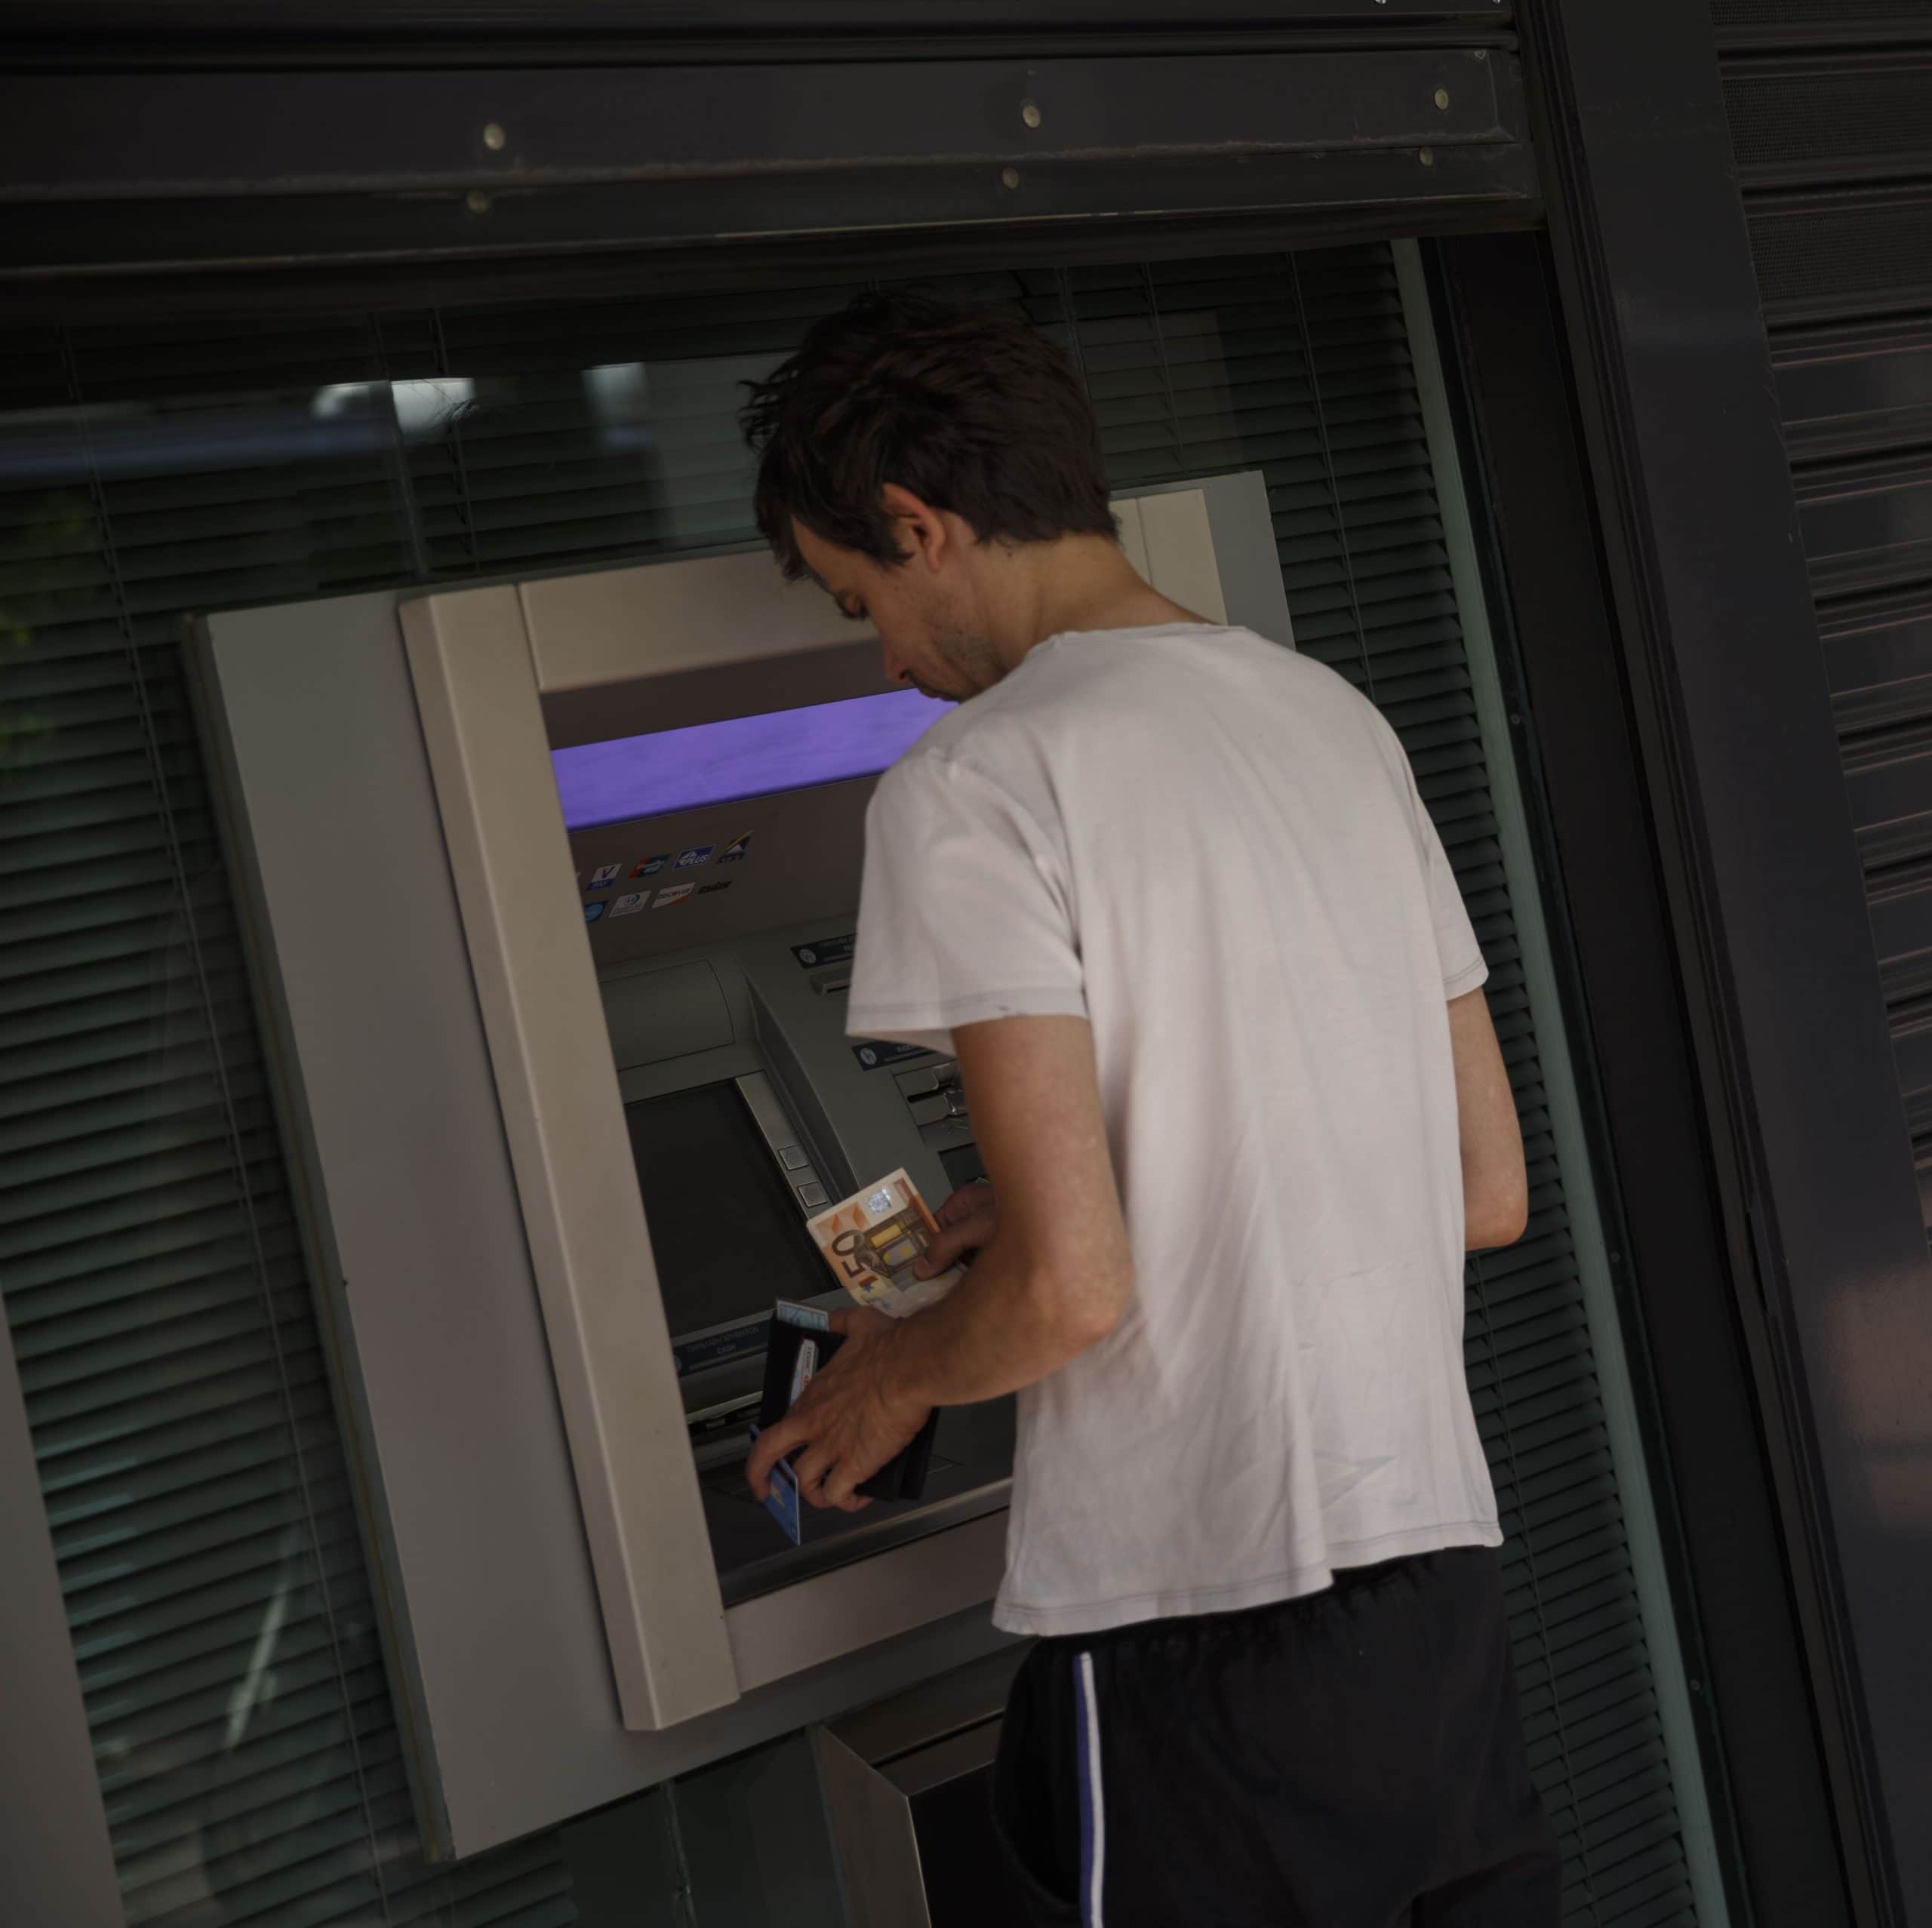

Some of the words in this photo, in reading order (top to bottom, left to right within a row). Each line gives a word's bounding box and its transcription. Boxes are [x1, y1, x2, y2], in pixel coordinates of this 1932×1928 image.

[681, 853, 709, 866] PLUS
[832, 1229, 866, 1278] 50
[716, 1342, 737, 1355] CASH
